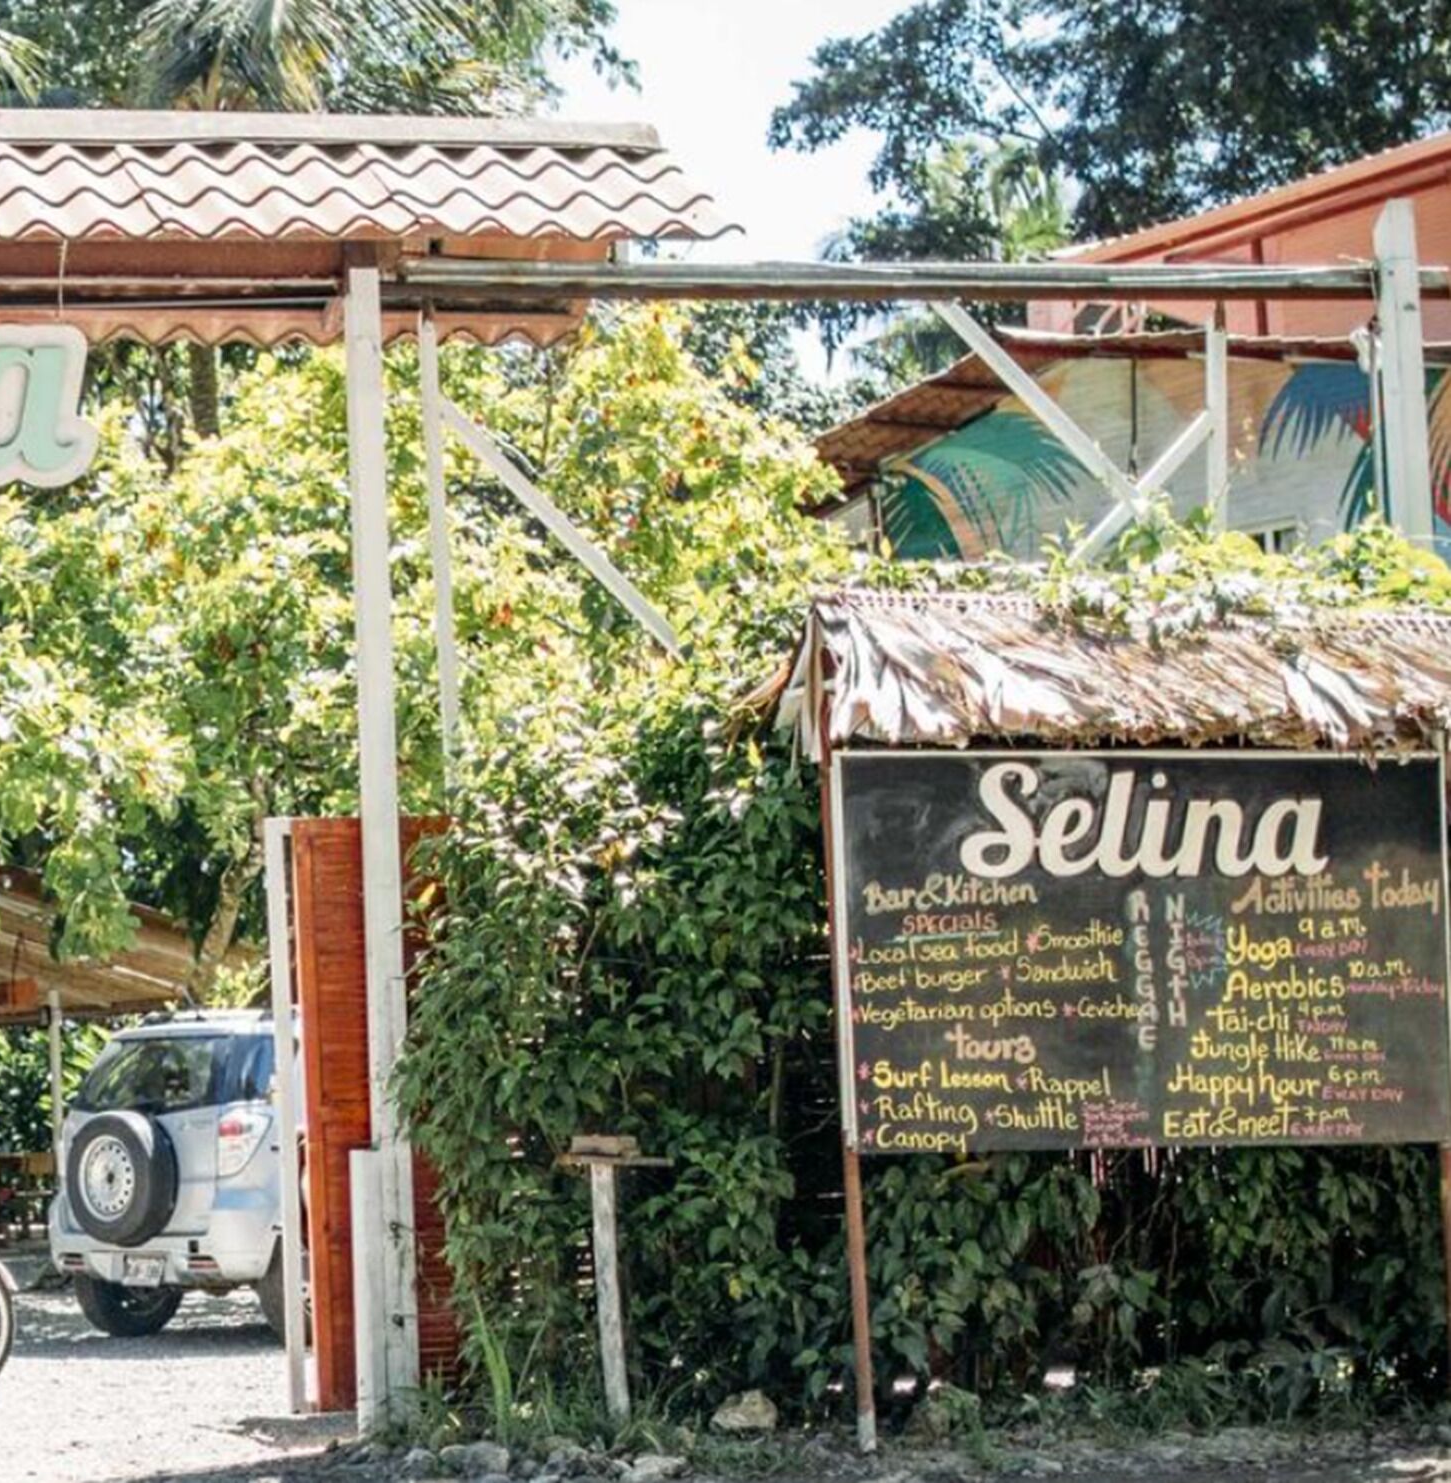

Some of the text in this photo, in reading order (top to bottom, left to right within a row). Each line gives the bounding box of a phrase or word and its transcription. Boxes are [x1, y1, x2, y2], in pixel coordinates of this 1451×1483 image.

[960, 762, 1329, 877] Selina
[919, 944, 959, 962] sea
[963, 928, 1018, 957] food
[1037, 919, 1124, 950] Smoothie
[1225, 923, 1293, 970] Yoga
[915, 965, 989, 992] burger
[1016, 951, 1119, 982] Sandwich
[1223, 964, 1346, 1002] Aerobics
[858, 987, 1057, 1031] Vegetarian options
[1190, 1029, 1269, 1072] Jungle
[871, 1060, 933, 1089] Surf
[1021, 1065, 1111, 1104] Rappel
[1166, 1058, 1321, 1107] Happy hour
[872, 1091, 979, 1135] Rafting
[993, 1096, 1080, 1131] Shuttle
[875, 1123, 966, 1153] Canopy
